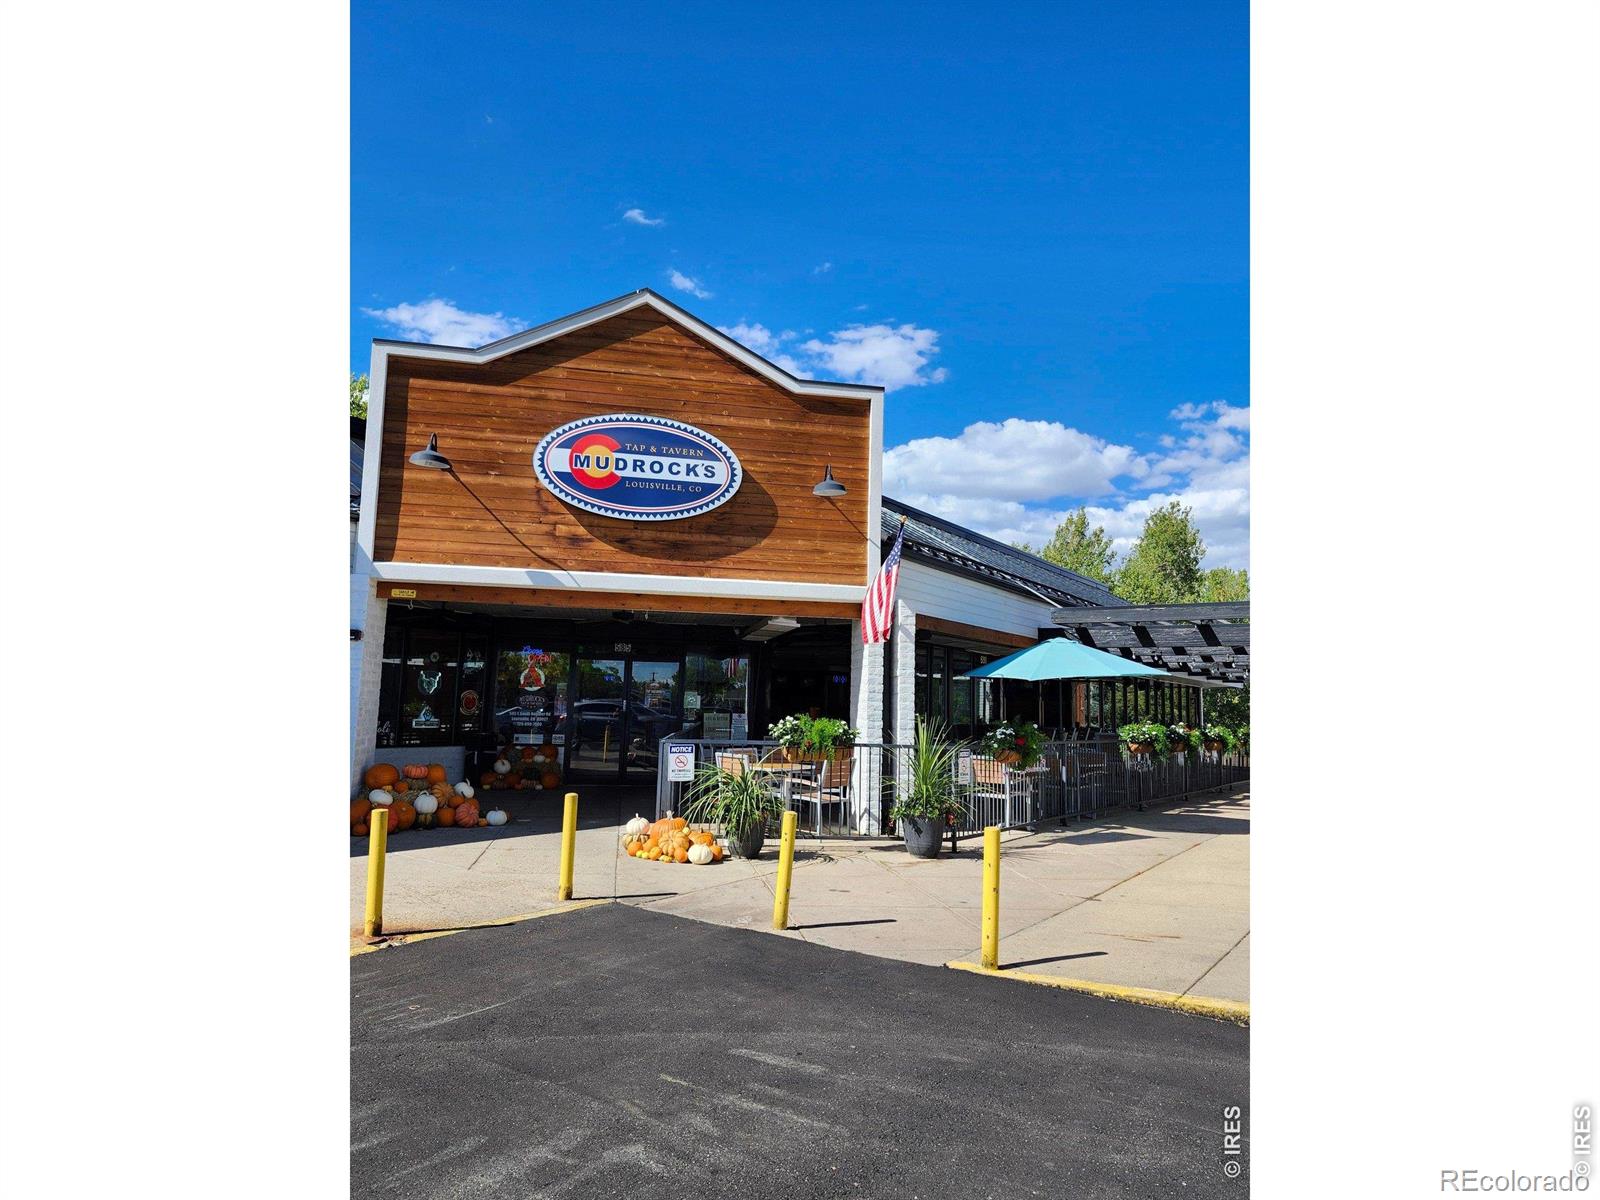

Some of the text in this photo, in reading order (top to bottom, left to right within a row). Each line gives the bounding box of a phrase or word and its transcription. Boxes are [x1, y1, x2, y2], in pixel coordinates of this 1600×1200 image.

[625, 443, 646, 452] TAP
[661, 446, 704, 457] TAVERN
[573, 454, 716, 479] MUDROCK'S
[625, 480, 702, 493] LOUISVILLE, CO
